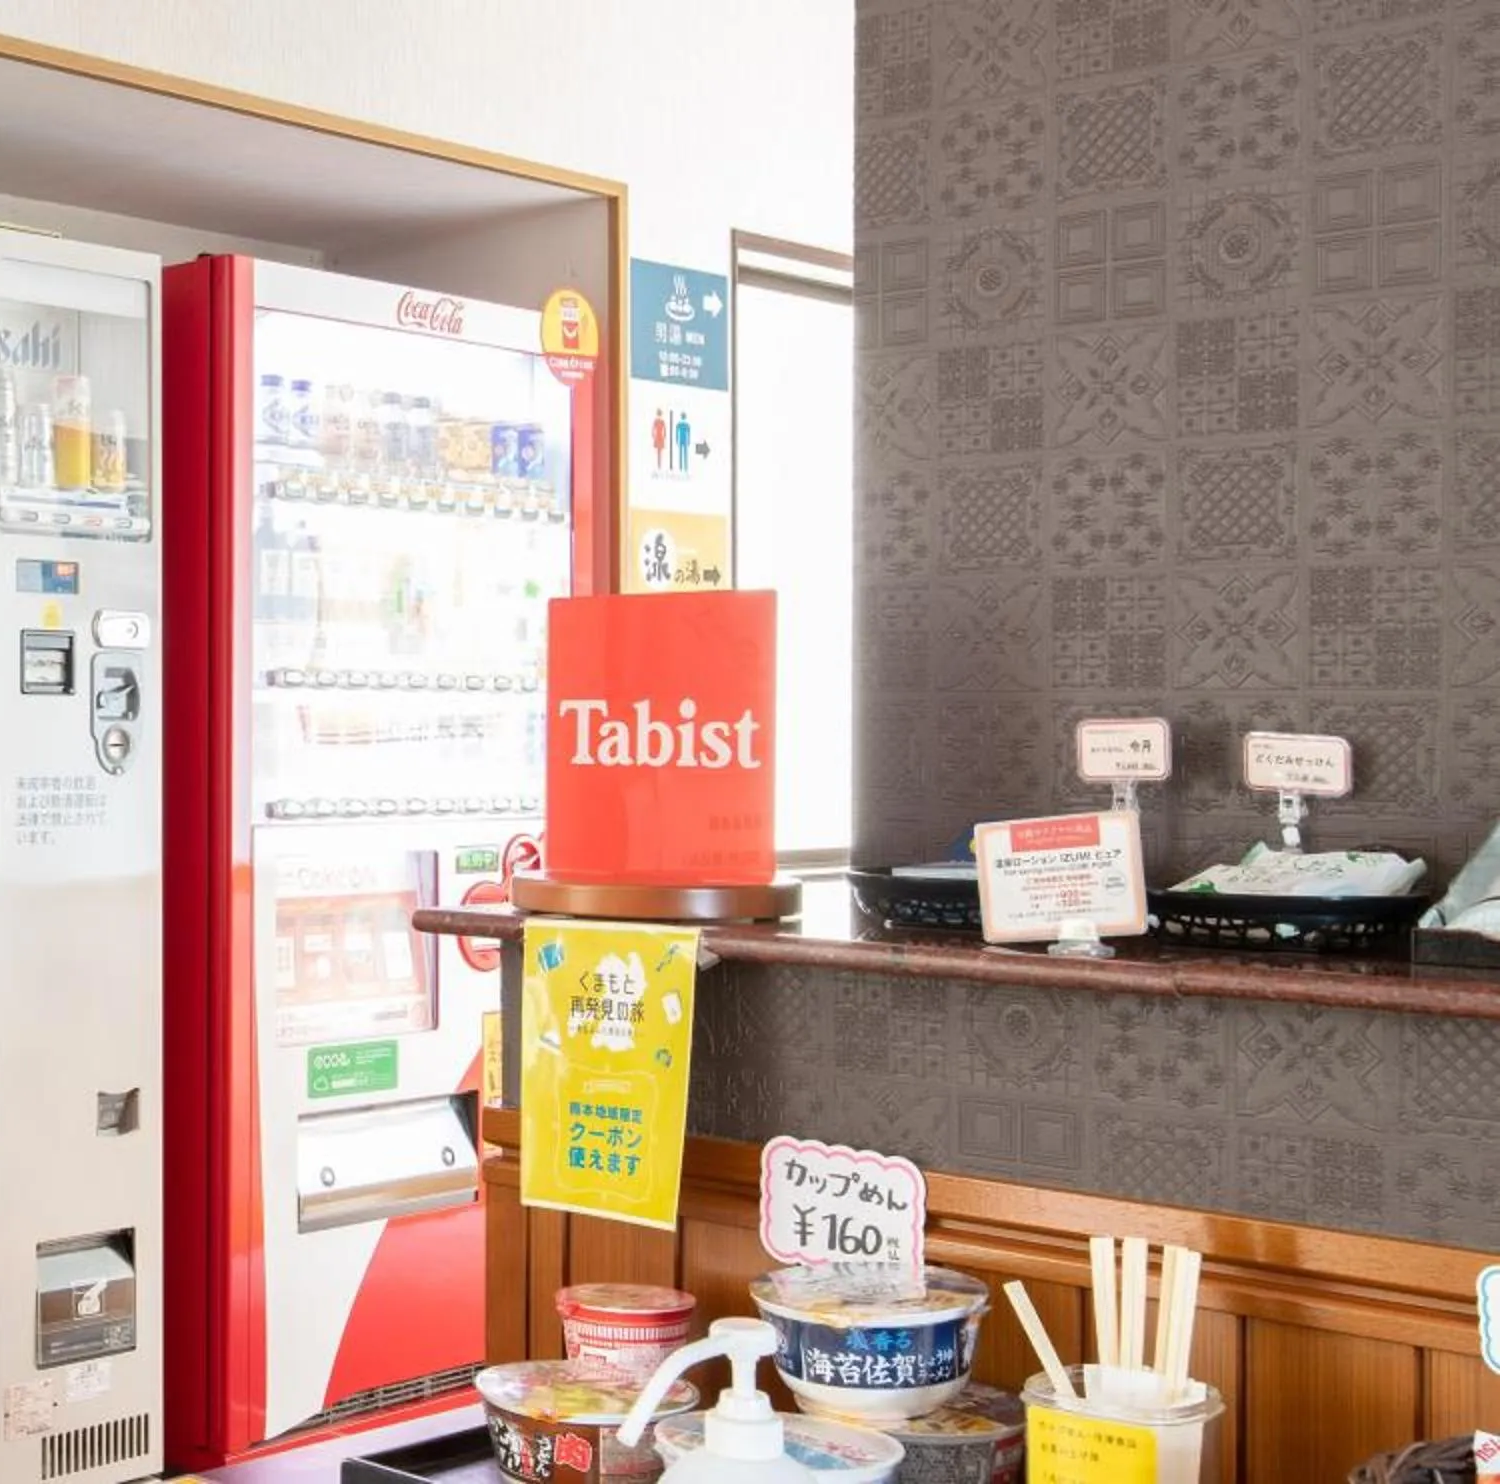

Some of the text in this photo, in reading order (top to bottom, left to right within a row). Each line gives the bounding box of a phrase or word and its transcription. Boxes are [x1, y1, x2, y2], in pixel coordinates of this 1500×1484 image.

[558, 697, 762, 769] Tabist
[579, 971, 637, 995] くまもと
[570, 995, 645, 1024] 再発見の旅
[568, 1101, 644, 1125] 熊本地域限定
[568, 1122, 643, 1150] クーポン
[567, 1146, 642, 1177] 使えます
[784, 1159, 908, 1211] カップめん
[792, 1203, 883, 1256] ¥160
[805, 1347, 916, 1386] 海苔佐賀
